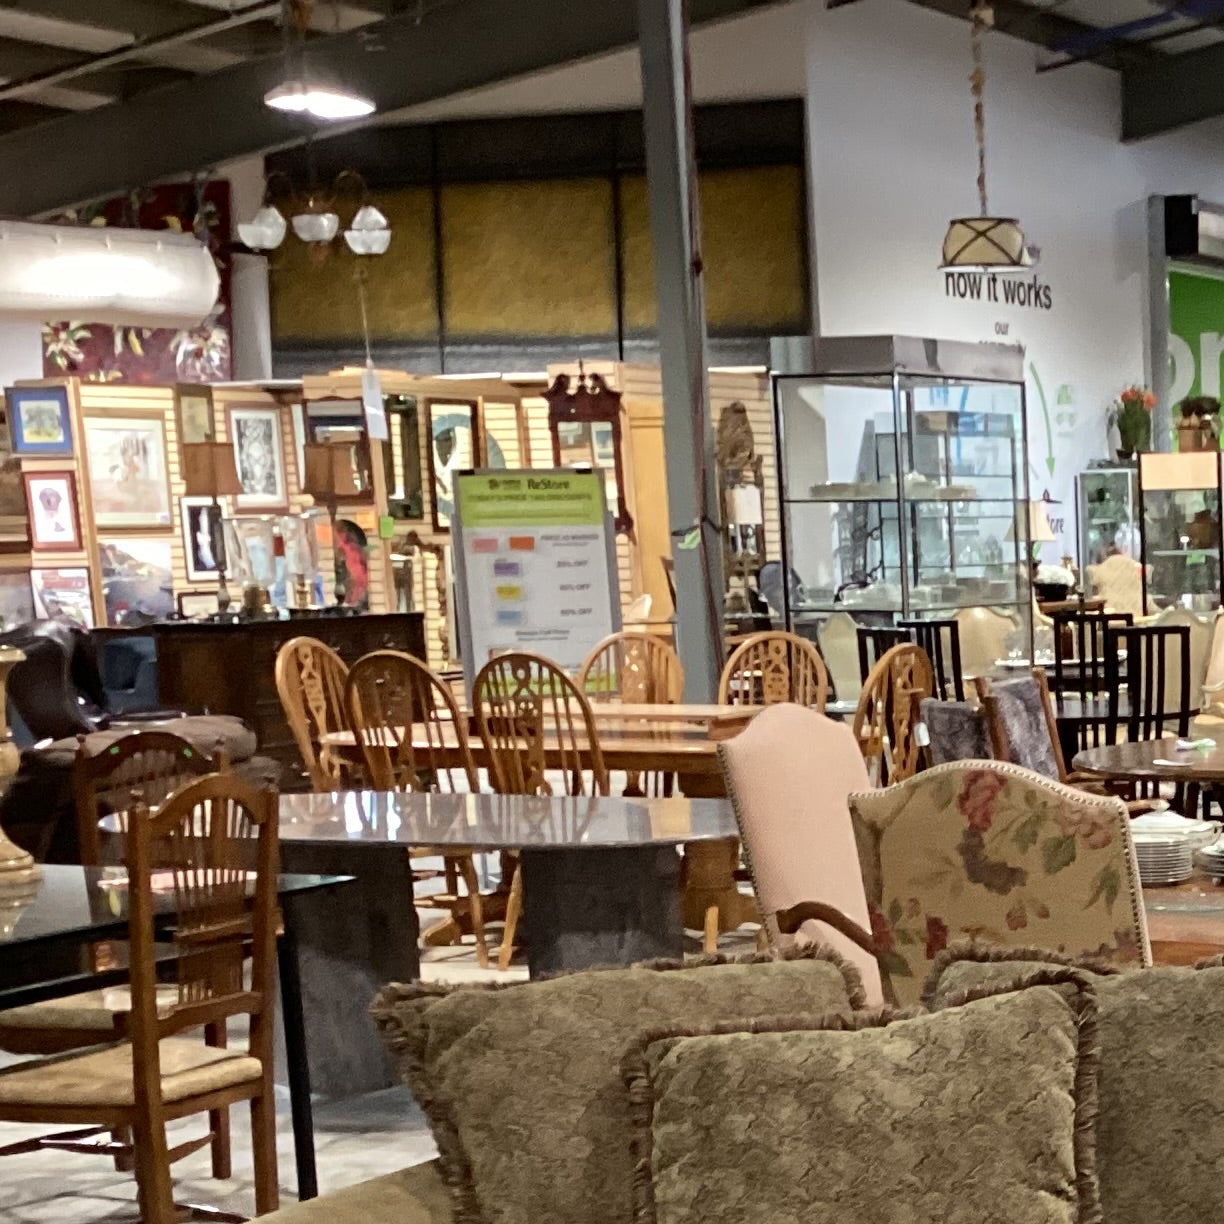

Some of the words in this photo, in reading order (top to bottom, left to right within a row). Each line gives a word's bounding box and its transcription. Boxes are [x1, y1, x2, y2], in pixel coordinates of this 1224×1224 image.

[987, 273, 999, 303] it
[1003, 274, 1052, 310] works
[994, 321, 1009, 336] our
[527, 478, 570, 490] ReStore
